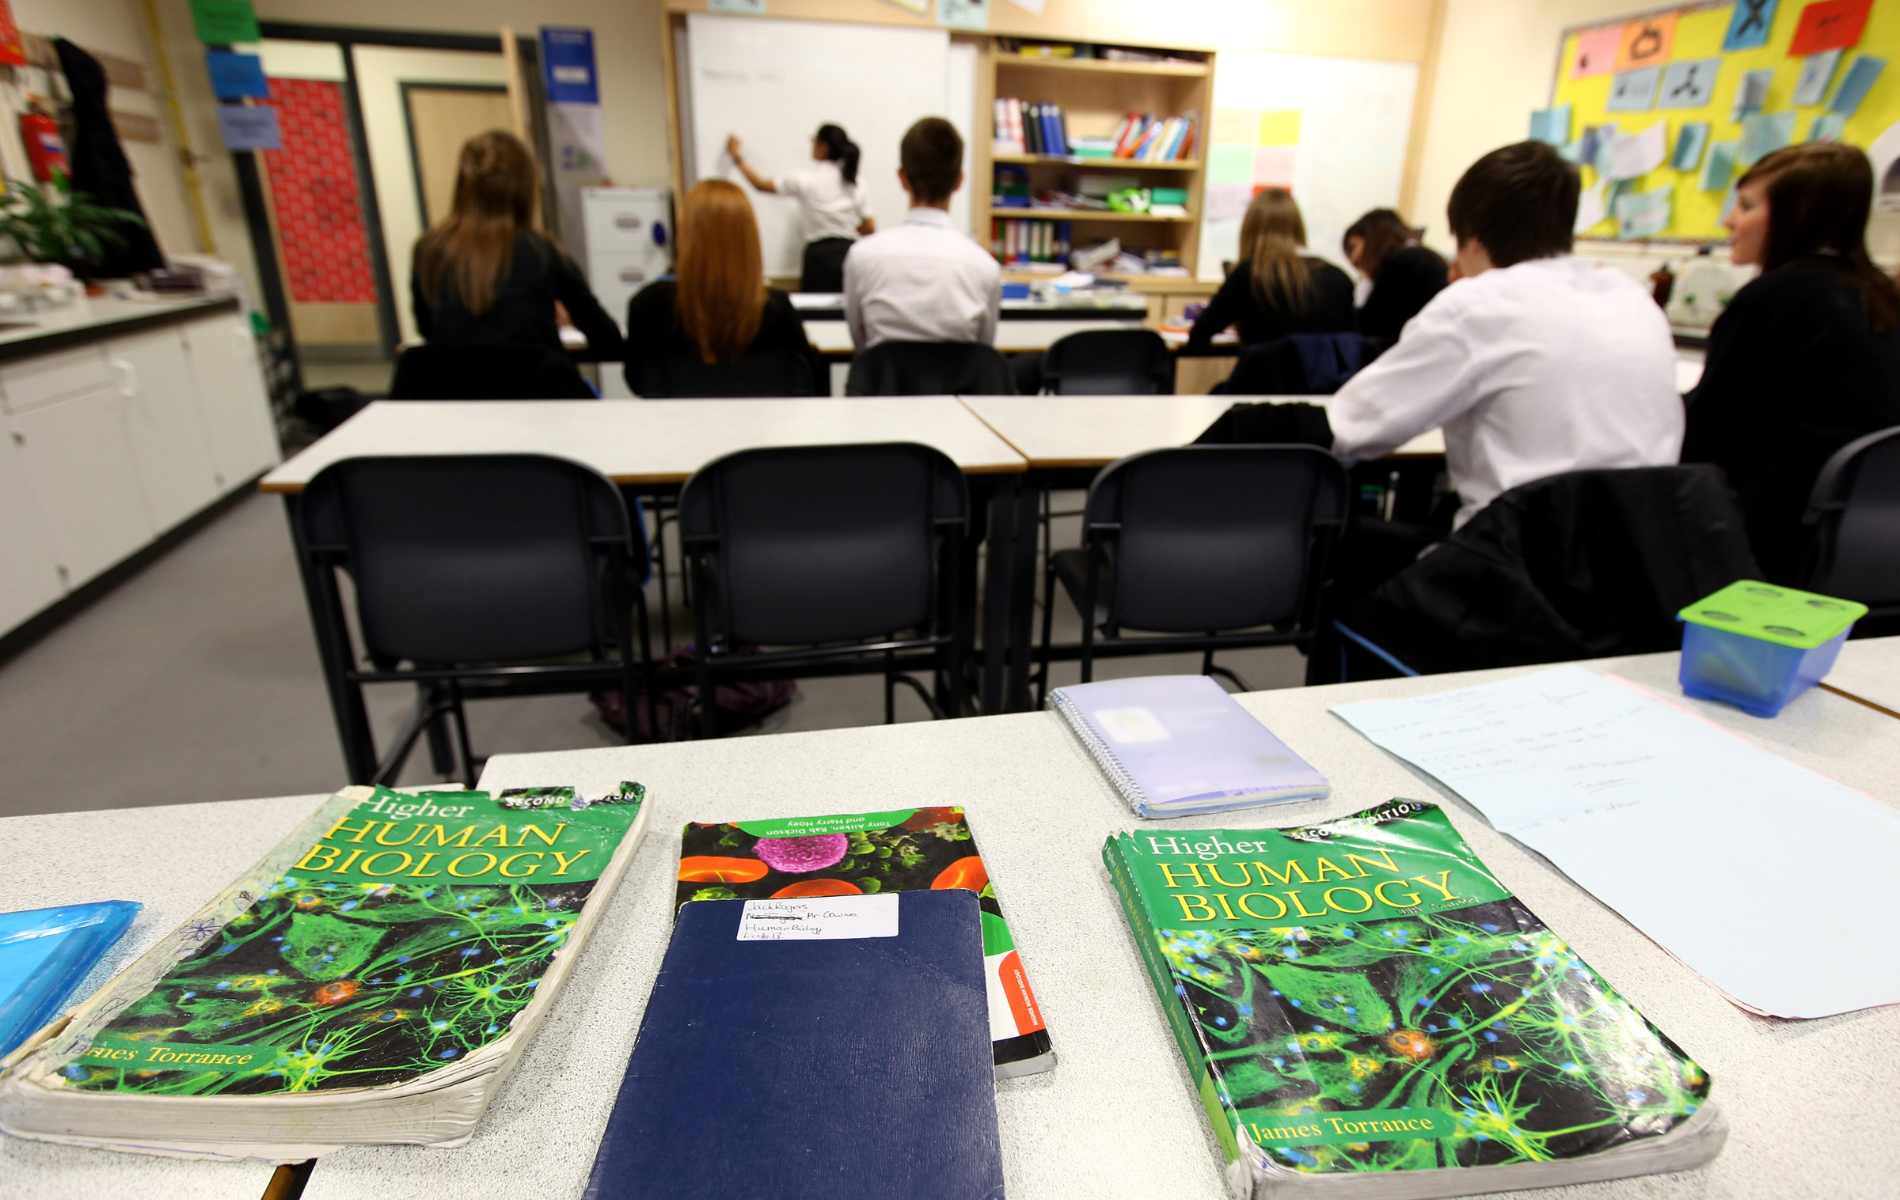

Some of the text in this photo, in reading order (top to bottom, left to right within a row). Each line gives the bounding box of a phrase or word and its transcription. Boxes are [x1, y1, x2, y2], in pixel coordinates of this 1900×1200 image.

[322, 817, 566, 848] HUMAN
[1146, 835, 1267, 860] Higher
[293, 844, 591, 878] BIOLOGY
[1159, 849, 1400, 888] HUMAN
[1170, 870, 1459, 921] BIOLOGY
[145, 1047, 252, 1065] Torrance
[1250, 1117, 1435, 1144] James Torrance
